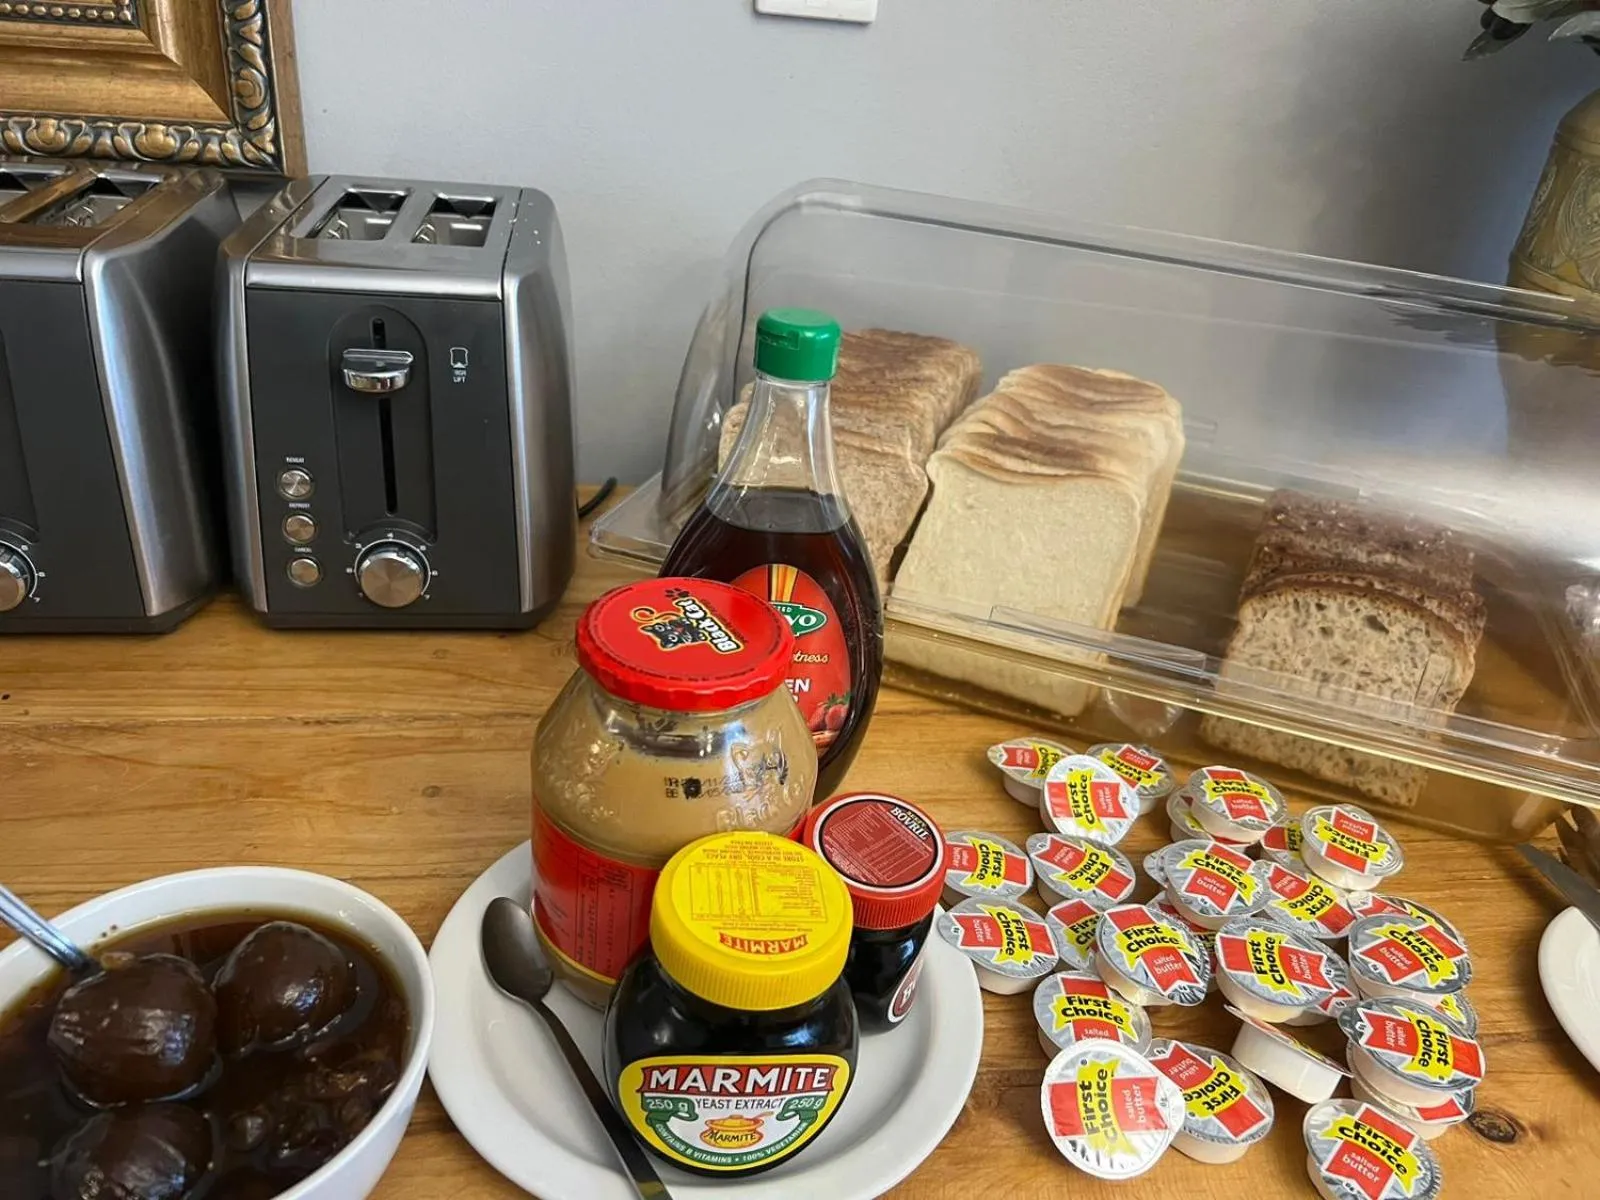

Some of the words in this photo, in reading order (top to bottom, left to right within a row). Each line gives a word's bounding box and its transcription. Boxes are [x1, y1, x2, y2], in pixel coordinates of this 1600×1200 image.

[676, 599, 705, 619] Cat
[783, 614, 818, 627] VO
[699, 618, 738, 651] Black
[793, 650, 829, 663] tness
[784, 678, 810, 693] EN
[1107, 754, 1152, 779] Choice
[1212, 786, 1263, 797] Choice
[1214, 780, 1251, 788] First
[1068, 781, 1083, 818] First
[1080, 774, 1095, 825] Choice
[890, 806, 930, 841] BOVRIL
[1323, 825, 1379, 853] Choice
[1329, 836, 1370, 858] First
[976, 843, 991, 880] Choice
[992, 850, 1003, 878] First
[1069, 852, 1100, 881] Choice
[1085, 862, 1110, 884] First
[1193, 858, 1248, 890] Choice
[1204, 853, 1246, 877] First
[1196, 879, 1227, 896] butter
[1288, 885, 1323, 909] Choice
[1305, 894, 1334, 916] First
[725, 934, 806, 954] MARMITE
[996, 911, 1016, 956] Choice
[1011, 918, 1030, 951] First
[1123, 924, 1162, 940] First
[1126, 933, 1181, 953] Choice
[1405, 929, 1445, 962] First
[1153, 954, 1176, 966] salted
[1249, 940, 1268, 976] First
[1266, 936, 1285, 985] Choice
[1388, 929, 1439, 973] Choice
[1153, 962, 1184, 975] butter
[1298, 952, 1313, 981] butter
[1061, 1007, 1124, 1026] Choice
[1065, 995, 1112, 1010] First
[1084, 1027, 1110, 1037] salted
[1385, 1020, 1396, 1048] butter
[1415, 1018, 1433, 1068] Choice
[1433, 1028, 1450, 1067] First
[650, 1067, 831, 1094] MARMITE
[1182, 1071, 1231, 1102] Choice
[647, 1098, 673, 1110] 250
[695, 1098, 733, 1110] YEAST
[734, 1097, 785, 1110] EXTRACT
[1079, 1079, 1101, 1136] First
[1093, 1068, 1118, 1144] Choice
[1122, 1089, 1136, 1120] salted
[1131, 1084, 1147, 1124] butter
[1202, 1084, 1241, 1112] First
[655, 1123, 687, 1152] CONTAINS
[693, 1150, 732, 1163] VITAMINS
[743, 1152, 765, 1161] 100%
[707, 1129, 757, 1144] MARMITE
[1338, 1126, 1408, 1175] Choice
[1353, 1120, 1405, 1158] First
[1341, 1153, 1381, 1184] butter
[1350, 1151, 1380, 1173] salted
